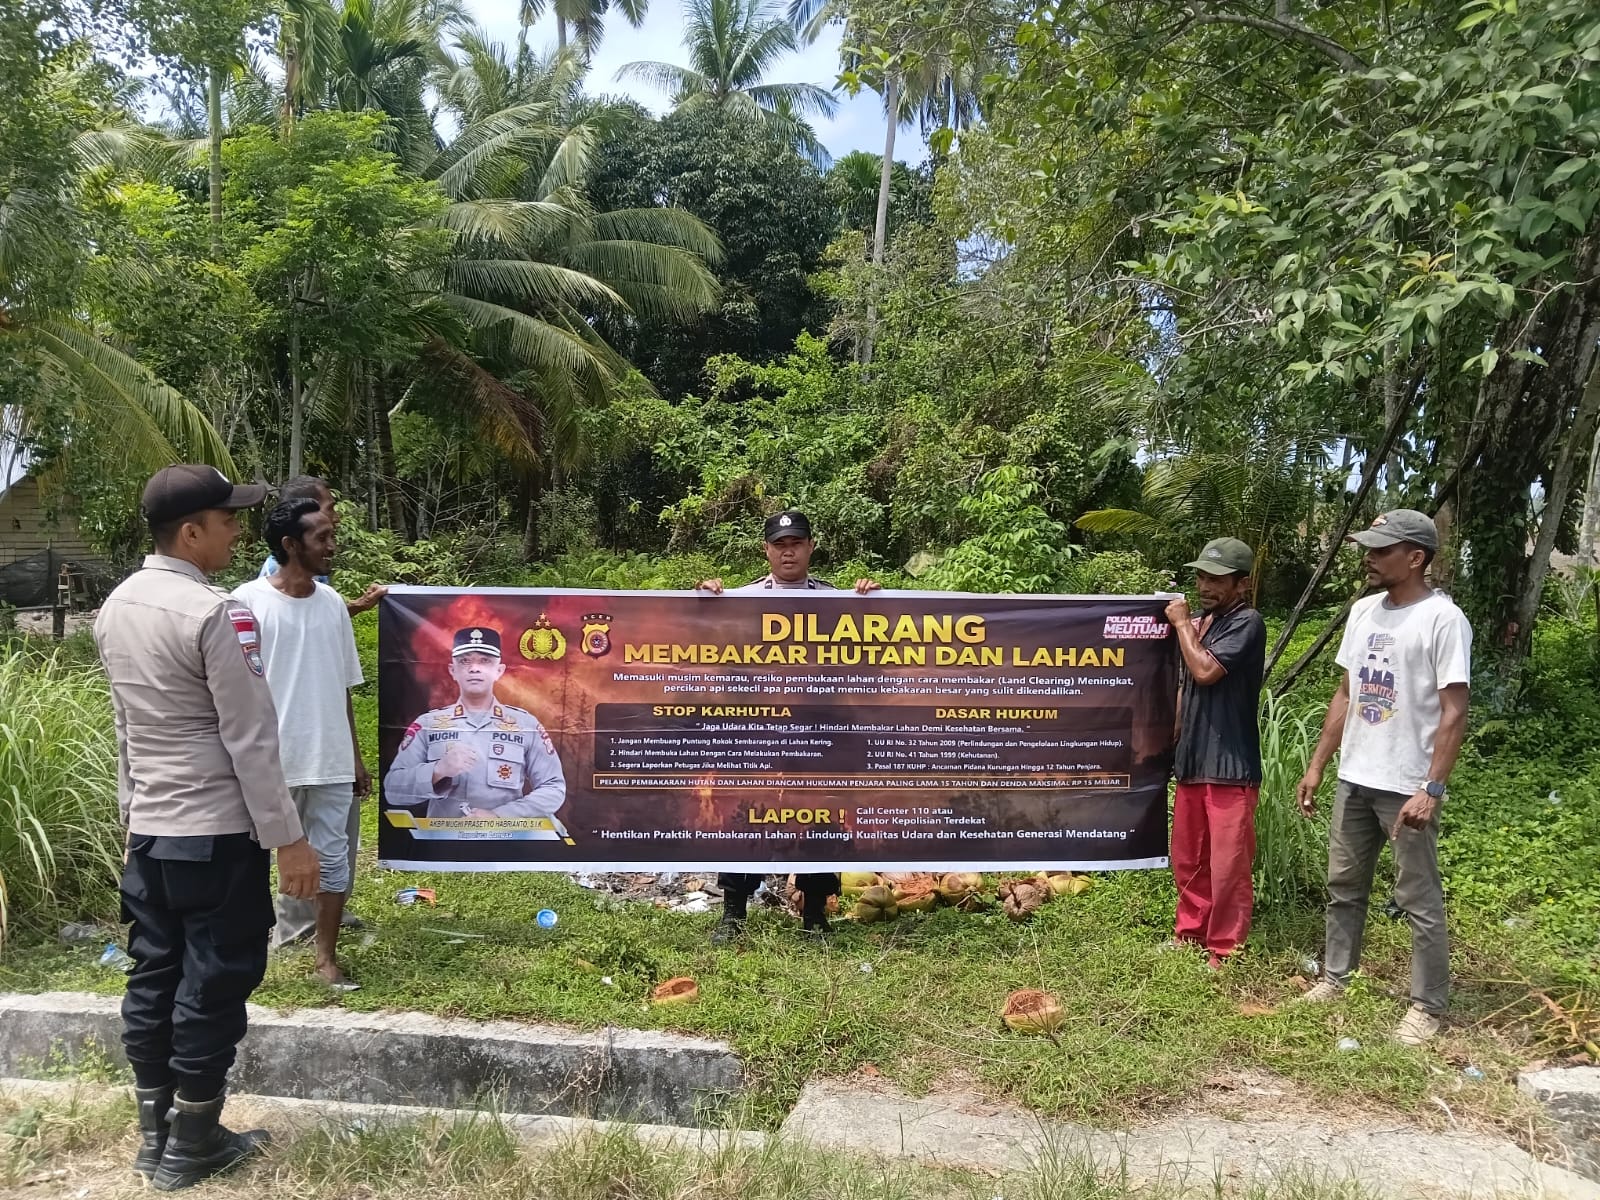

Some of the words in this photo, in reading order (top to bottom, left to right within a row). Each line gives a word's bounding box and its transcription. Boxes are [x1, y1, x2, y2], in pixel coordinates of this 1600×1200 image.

[762, 613, 986, 642] DILARANG
[1104, 624, 1168, 634] MEUTUAH
[624, 643, 807, 664] MEMBAKAR
[817, 646, 926, 665] HUTAN
[935, 646, 1003, 667] DAN
[1012, 646, 1125, 667] LAHAN
[613, 673, 665, 682] Memasuki
[704, 674, 750, 682] kemarau,
[753, 674, 782, 682] resiko
[785, 674, 844, 684] pembukaan
[847, 674, 874, 682] lahan
[878, 676, 915, 686] dengan
[942, 676, 994, 684] membakar
[998, 676, 1026, 686] (Land
[1029, 676, 1074, 686] Clearing)
[1078, 677, 1134, 687] Meningkat,
[664, 684, 706, 694] percikan
[710, 684, 725, 693] api
[728, 684, 760, 692] sekecil
[763, 685, 781, 694] apa
[784, 686, 803, 694] pun
[806, 685, 835, 694] dapat
[838, 685, 878, 694] memicu
[881, 686, 932, 694] kebakaran
[935, 687, 962, 695] besar
[965, 688, 989, 696] yang
[992, 687, 1013, 695] sulit
[1017, 687, 1084, 695] dikendalikan.
[653, 706, 696, 716] STOP
[701, 707, 791, 717] KARHUTLA
[935, 709, 990, 719] DASAR
[996, 708, 1058, 720] HUKUM
[702, 723, 720, 731] Jaga
[766, 724, 787, 733] Tetap
[790, 724, 812, 732] Segar
[429, 732, 458, 742] MUGHI
[492, 732, 523, 744] POLRI
[618, 737, 641, 746] Jangan
[643, 738, 680, 746] Membuang
[683, 738, 710, 747] Puntung
[735, 738, 779, 746] Sembarangan
[810, 739, 834, 747] Kering.
[958, 740, 1004, 748] (Perlindungan
[1060, 740, 1097, 748] Lingkungan
[1099, 740, 1124, 748] Hidup).
[700, 750, 725, 758] Dengan
[618, 762, 640, 770] Segera
[642, 762, 672, 770] Laporkan
[674, 762, 700, 770] Petugas
[760, 762, 772, 770] Api.
[1021, 763, 1044, 771] Hingga
[1077, 763, 1102, 771] Penjara.
[748, 808, 831, 824] LAPOR
[839, 808, 846, 824] !
[892, 818, 941, 826] Kepolisian
[696, 831, 761, 839] Pembakaran
[765, 831, 797, 839] Lahan
[806, 831, 853, 841] Lindungi
[857, 831, 898, 839] Kualitas
[901, 831, 933, 839] Udara
[936, 831, 956, 839] dan
[960, 830, 1014, 838] Kesehatan
[1017, 830, 1062, 838] Generasi
[1066, 830, 1126, 840] Mendatang
